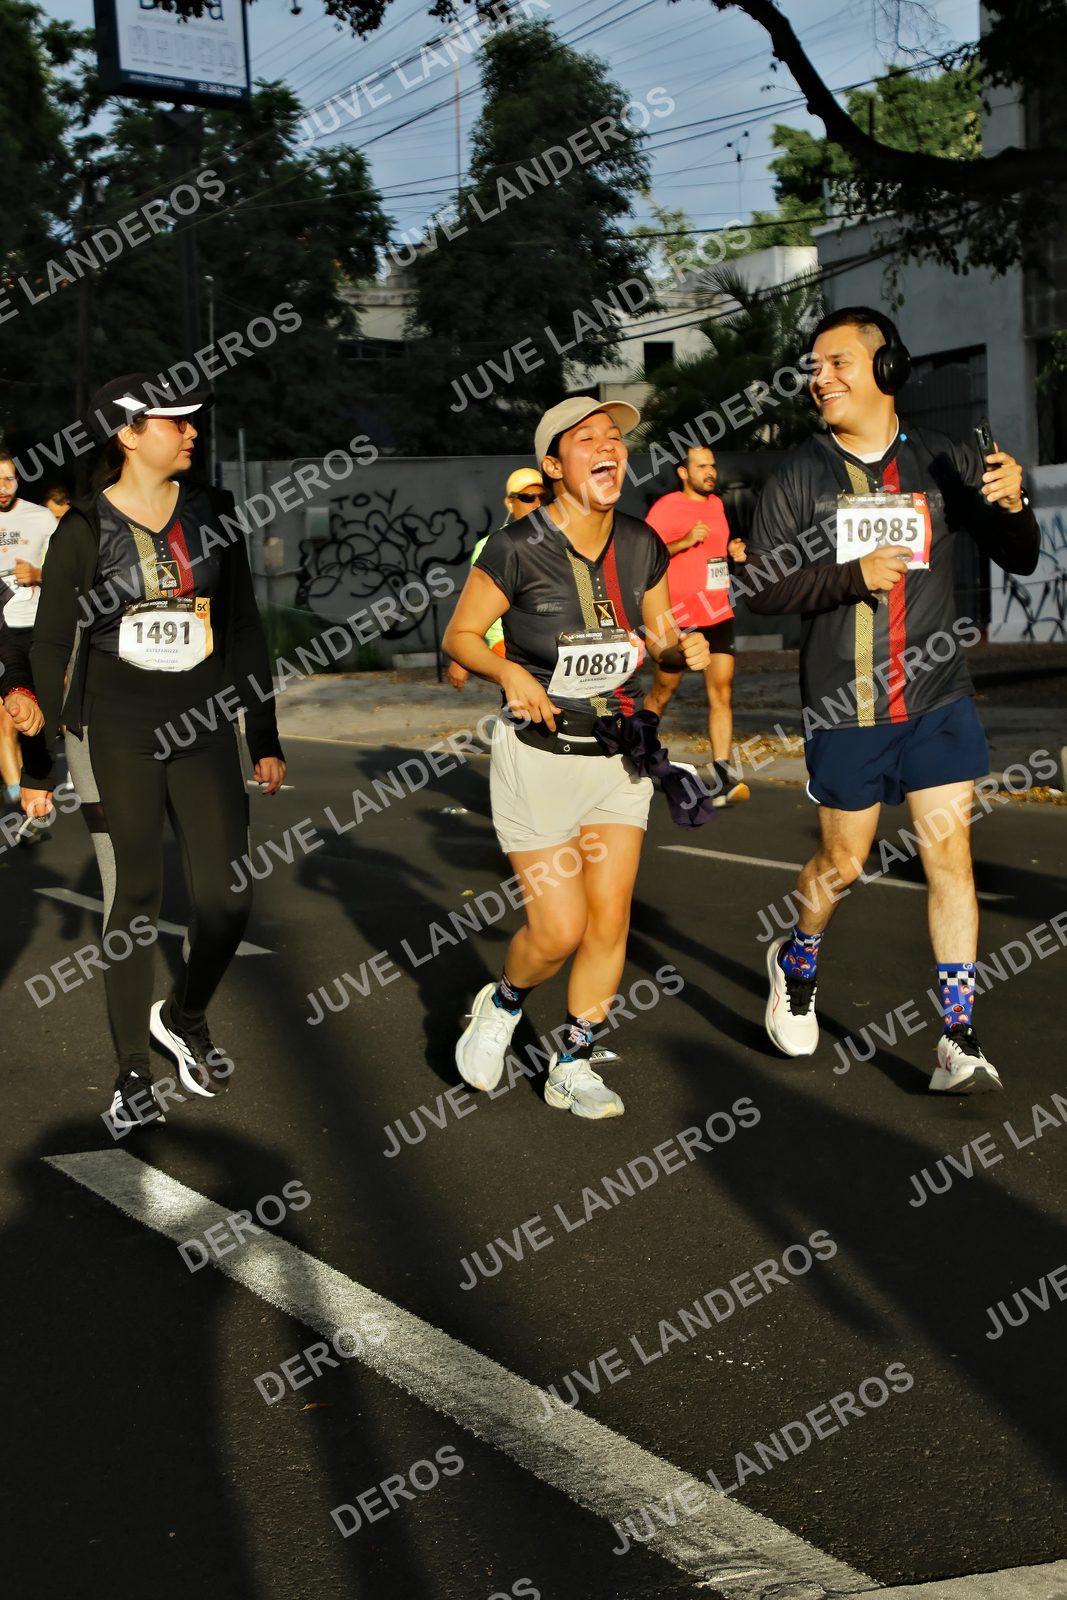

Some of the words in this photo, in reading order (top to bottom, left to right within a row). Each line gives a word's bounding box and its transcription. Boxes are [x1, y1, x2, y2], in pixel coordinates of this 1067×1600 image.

[330, 488, 396, 514] TOY
[842, 517, 918, 542] 10985
[196, 601, 208, 613] 5K
[132, 620, 190, 645] 1491
[563, 651, 631, 677] 10881
